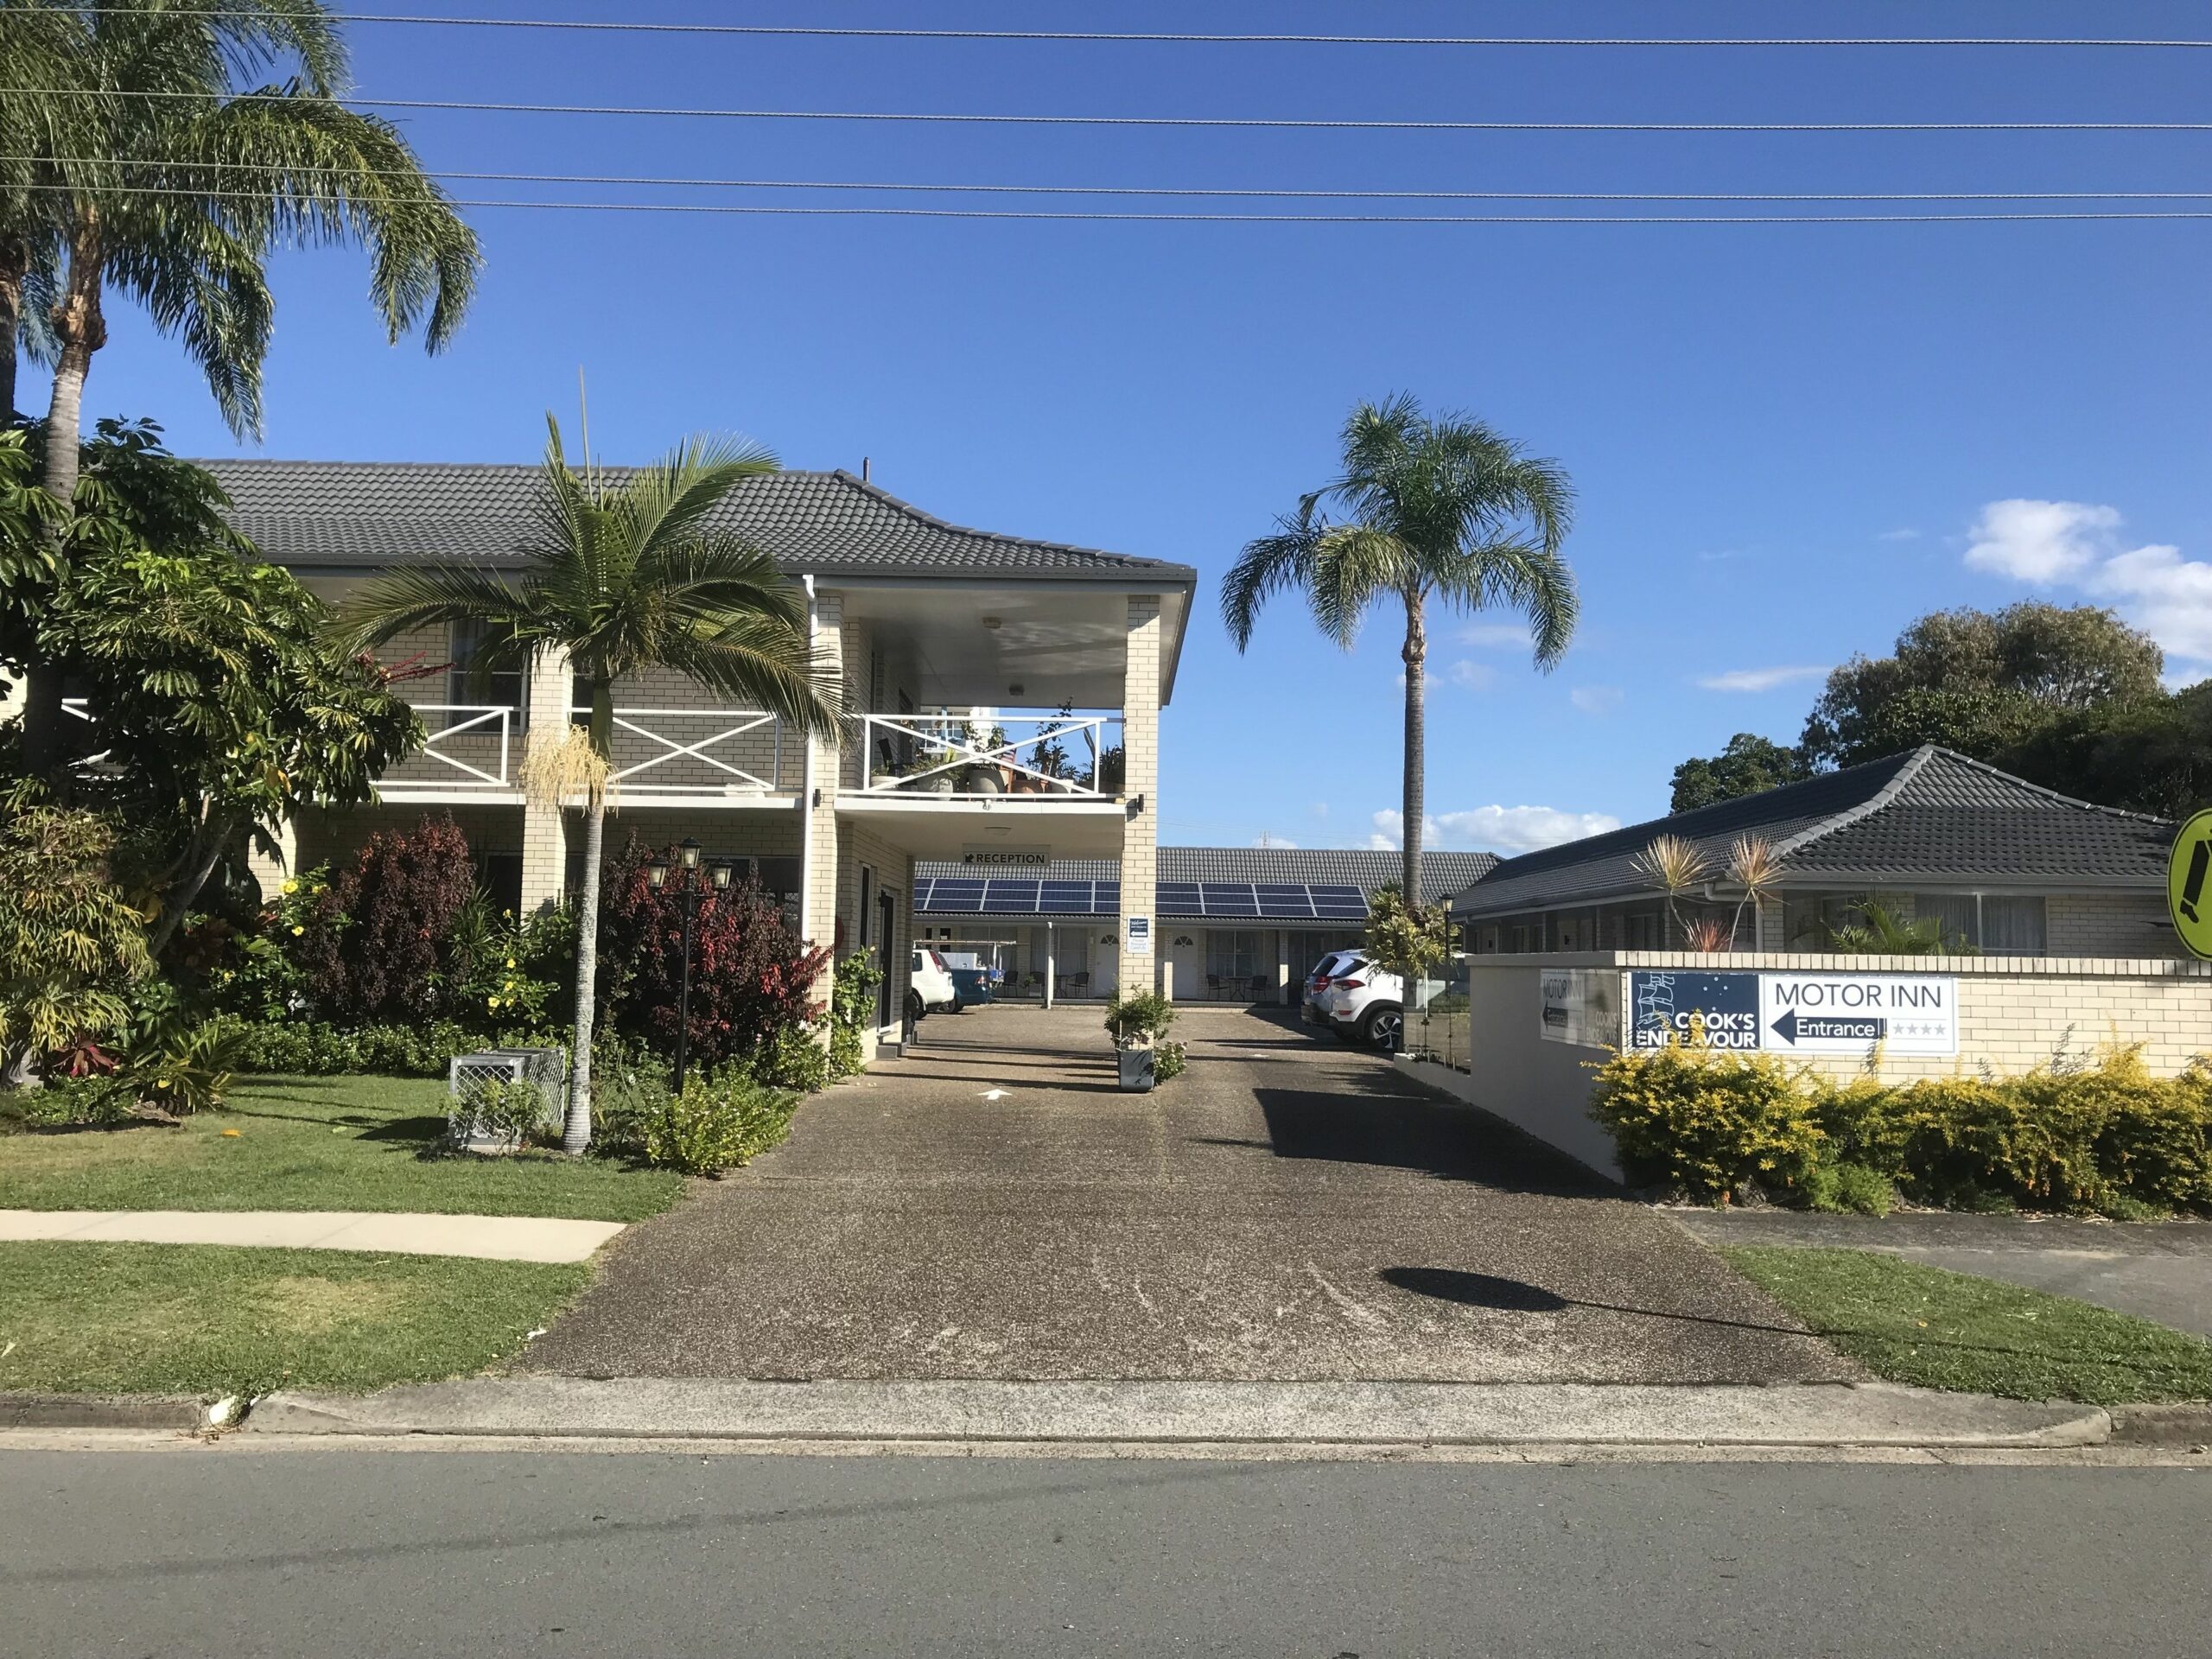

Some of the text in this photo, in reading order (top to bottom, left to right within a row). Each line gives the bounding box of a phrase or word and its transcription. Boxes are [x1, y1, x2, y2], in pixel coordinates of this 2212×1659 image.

[976, 854, 1045, 863] RECEPTION
[1543, 978, 1567, 999] MOTOR
[1776, 983, 1941, 1007] MOTOR INN
[1675, 1012, 1755, 1030] COOK'S
[1796, 1019, 1875, 1037] Entrance
[1637, 1030, 1755, 1047] ENDEVOUR
